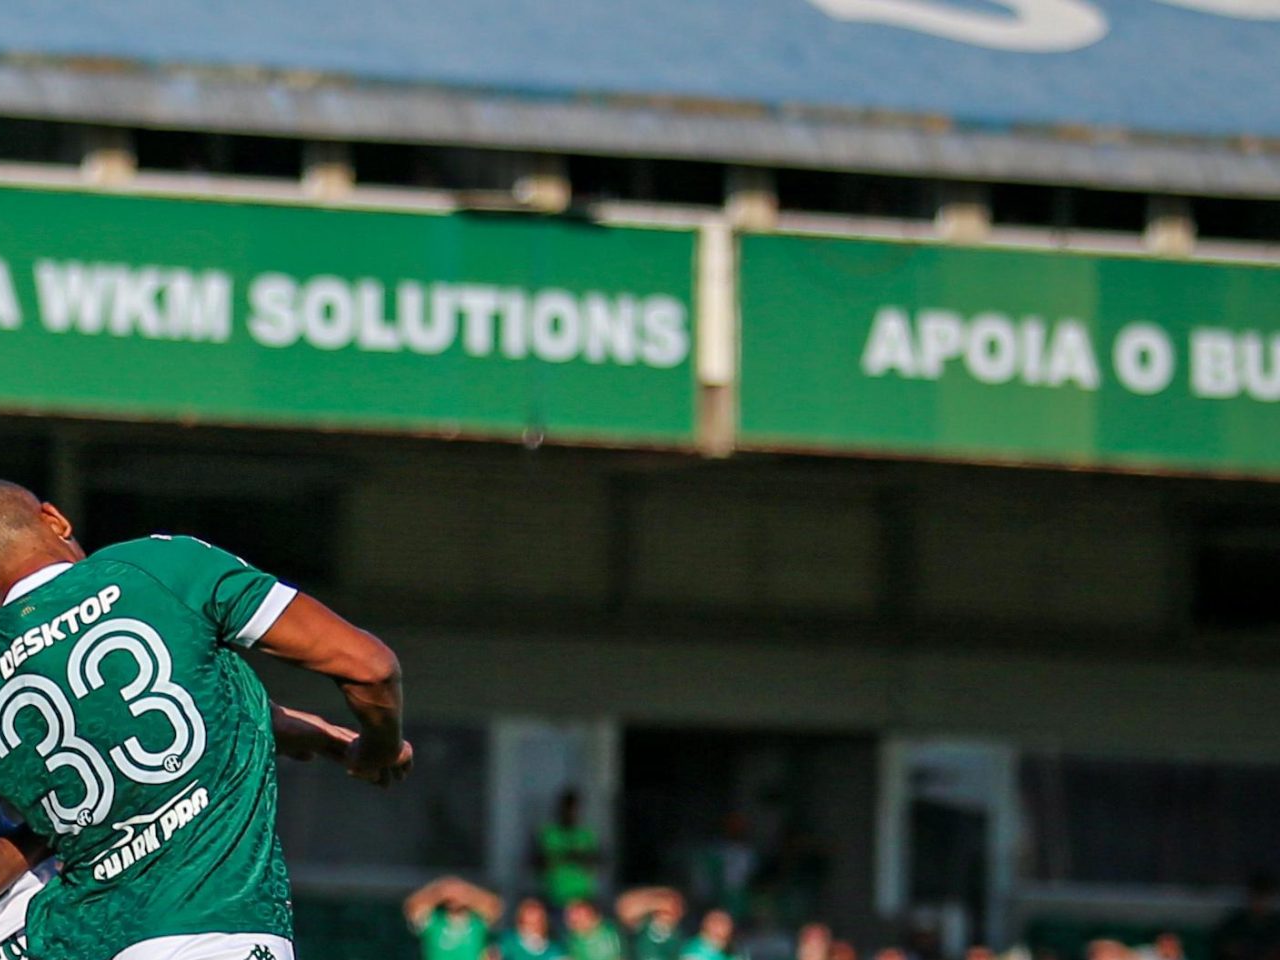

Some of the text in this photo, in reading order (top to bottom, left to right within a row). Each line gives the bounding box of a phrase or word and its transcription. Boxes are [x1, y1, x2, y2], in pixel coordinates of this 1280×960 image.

[32, 256, 234, 345] WKM
[246, 270, 690, 369] SOLUTIONS
[860, 304, 1280, 403] APOIA O BU
[0, 584, 122, 681] DESKTOP
